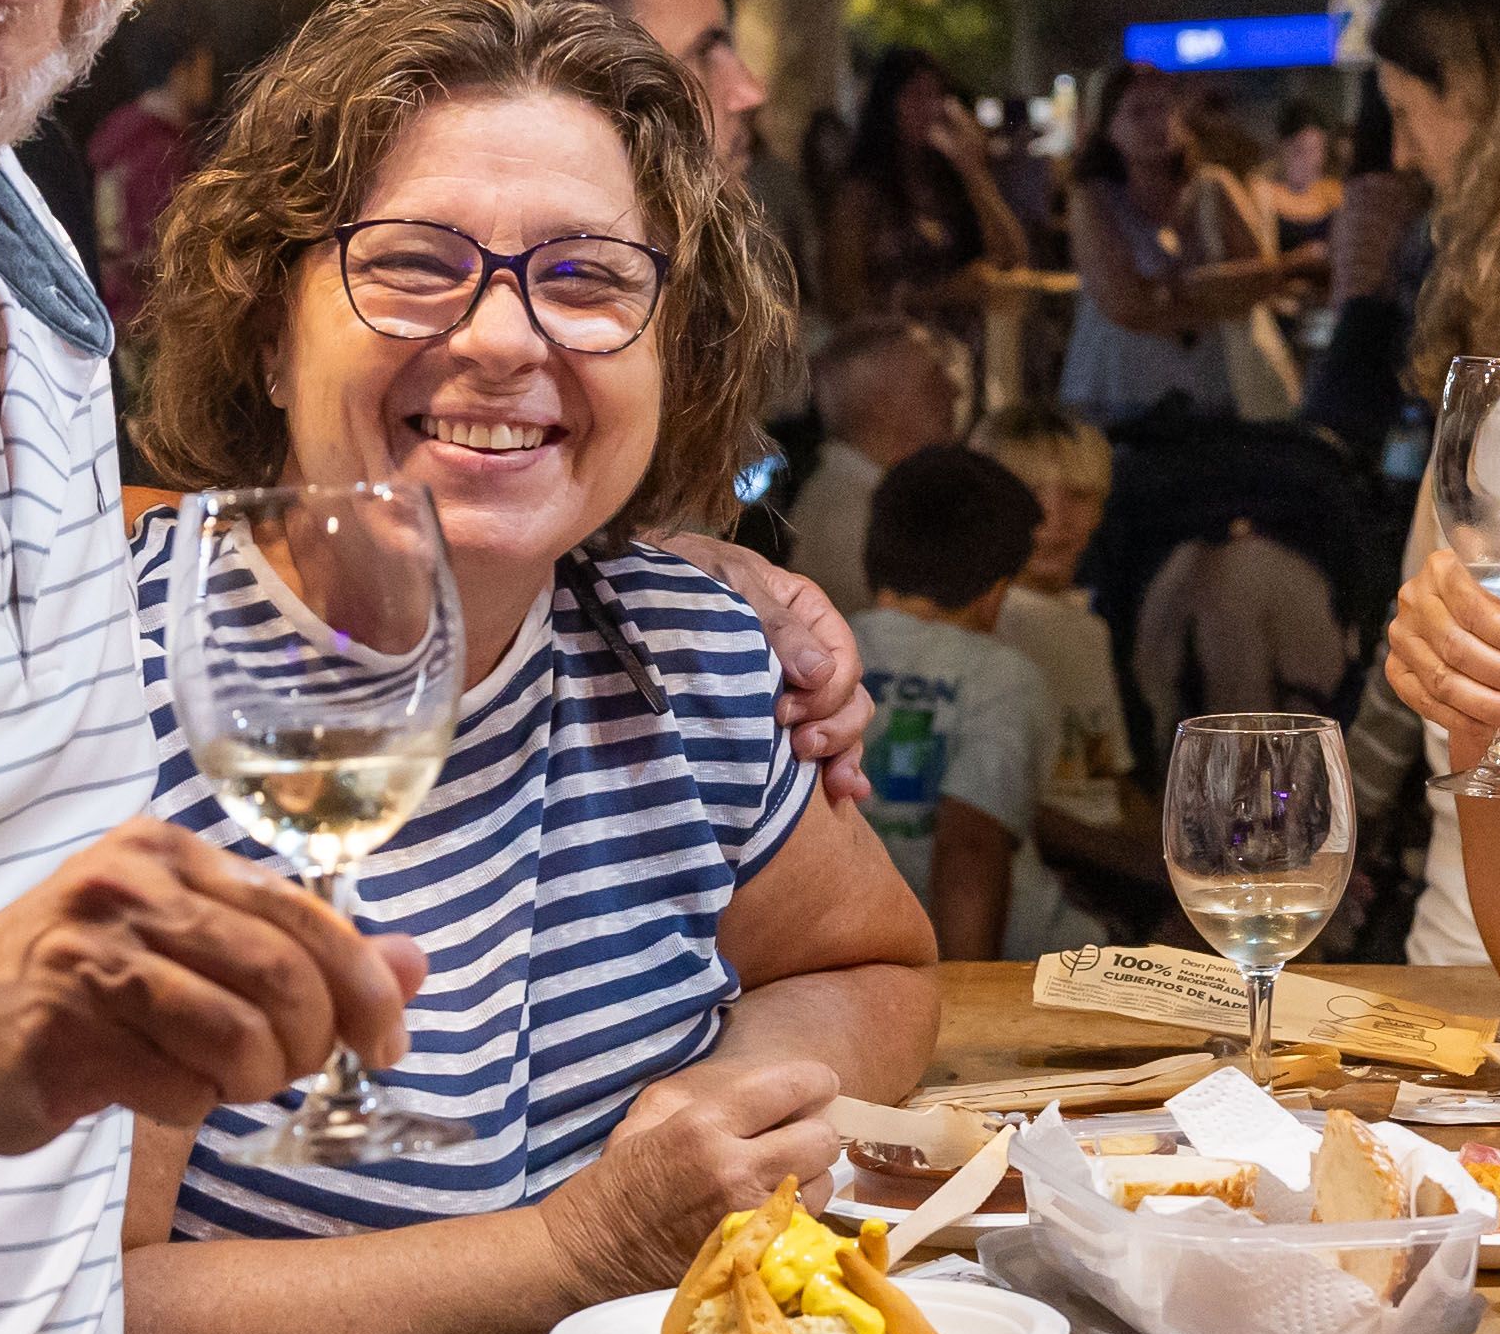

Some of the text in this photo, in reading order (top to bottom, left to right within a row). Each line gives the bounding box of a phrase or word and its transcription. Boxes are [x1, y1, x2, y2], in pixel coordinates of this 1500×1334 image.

[1113, 953, 1173, 977] 100%
[1181, 958, 1206, 969] Don
[1176, 975, 1248, 999] BIODEGRADA
[1180, 969, 1228, 984] NATURAL
[1103, 971, 1249, 1010] CUBIERTOS DE MADE
